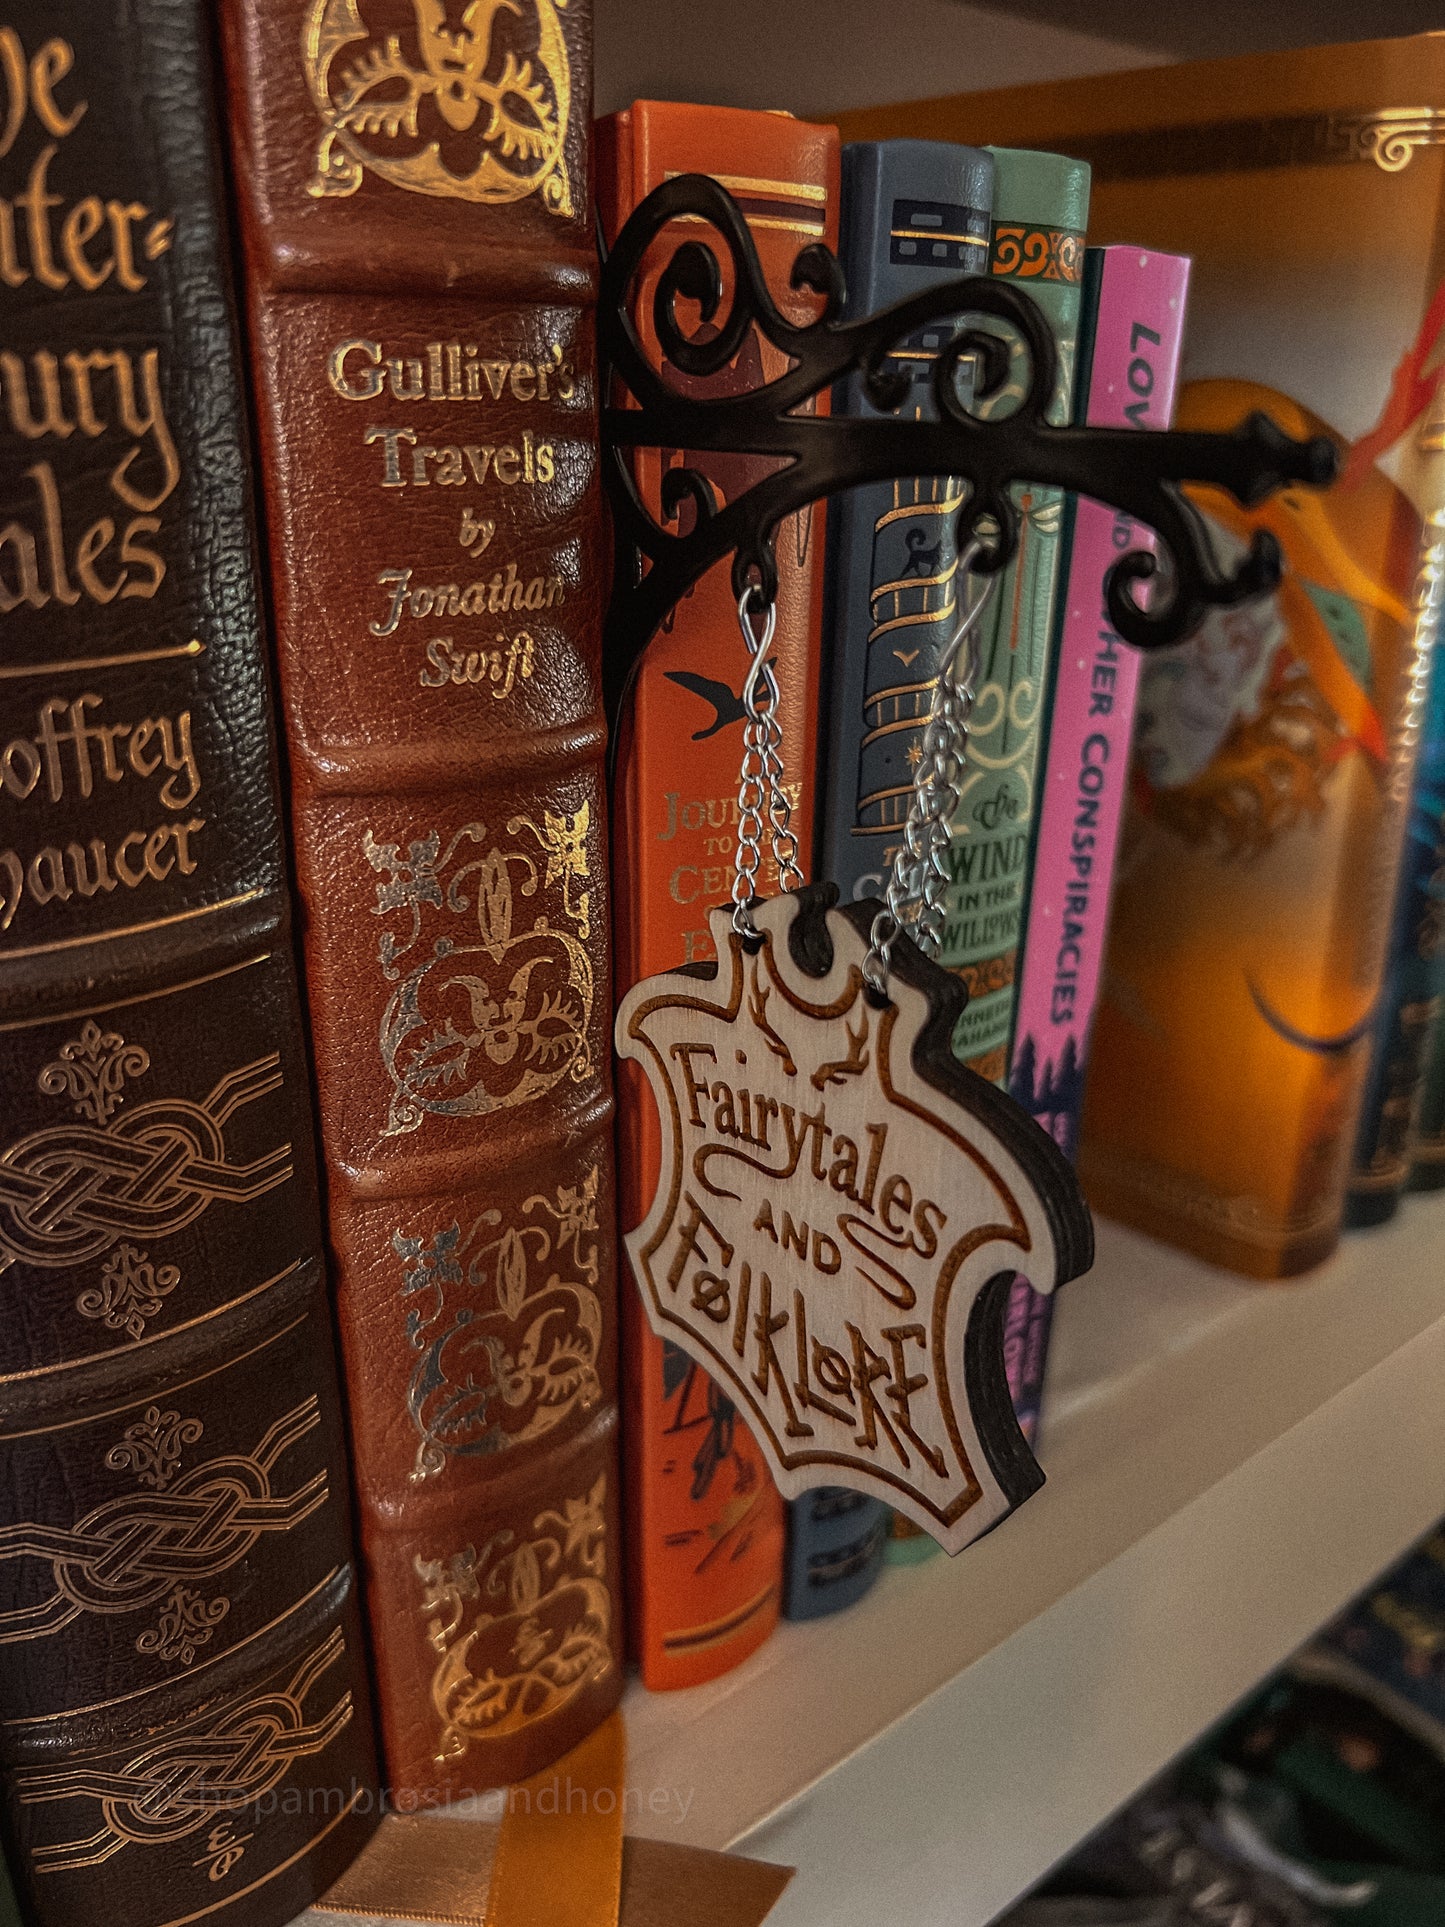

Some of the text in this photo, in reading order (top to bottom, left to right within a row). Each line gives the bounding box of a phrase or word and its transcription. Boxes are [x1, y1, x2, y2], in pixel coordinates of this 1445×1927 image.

[328, 338, 575, 400] Gulliver's
[1123, 322, 1161, 432] LOV
[364, 427, 555, 487] Travels
[459, 507, 496, 558] by
[369, 563, 565, 637] Jonathan
[420, 630, 535, 699] Swift
[703, 836, 732, 860] TO
[949, 835, 1026, 886] WIND
[1050, 734, 1111, 1027] CONSPIRACIES
[957, 892, 980, 911] IN
[670, 1043, 948, 1262] Fairytales
[753, 1199, 842, 1275] AND
